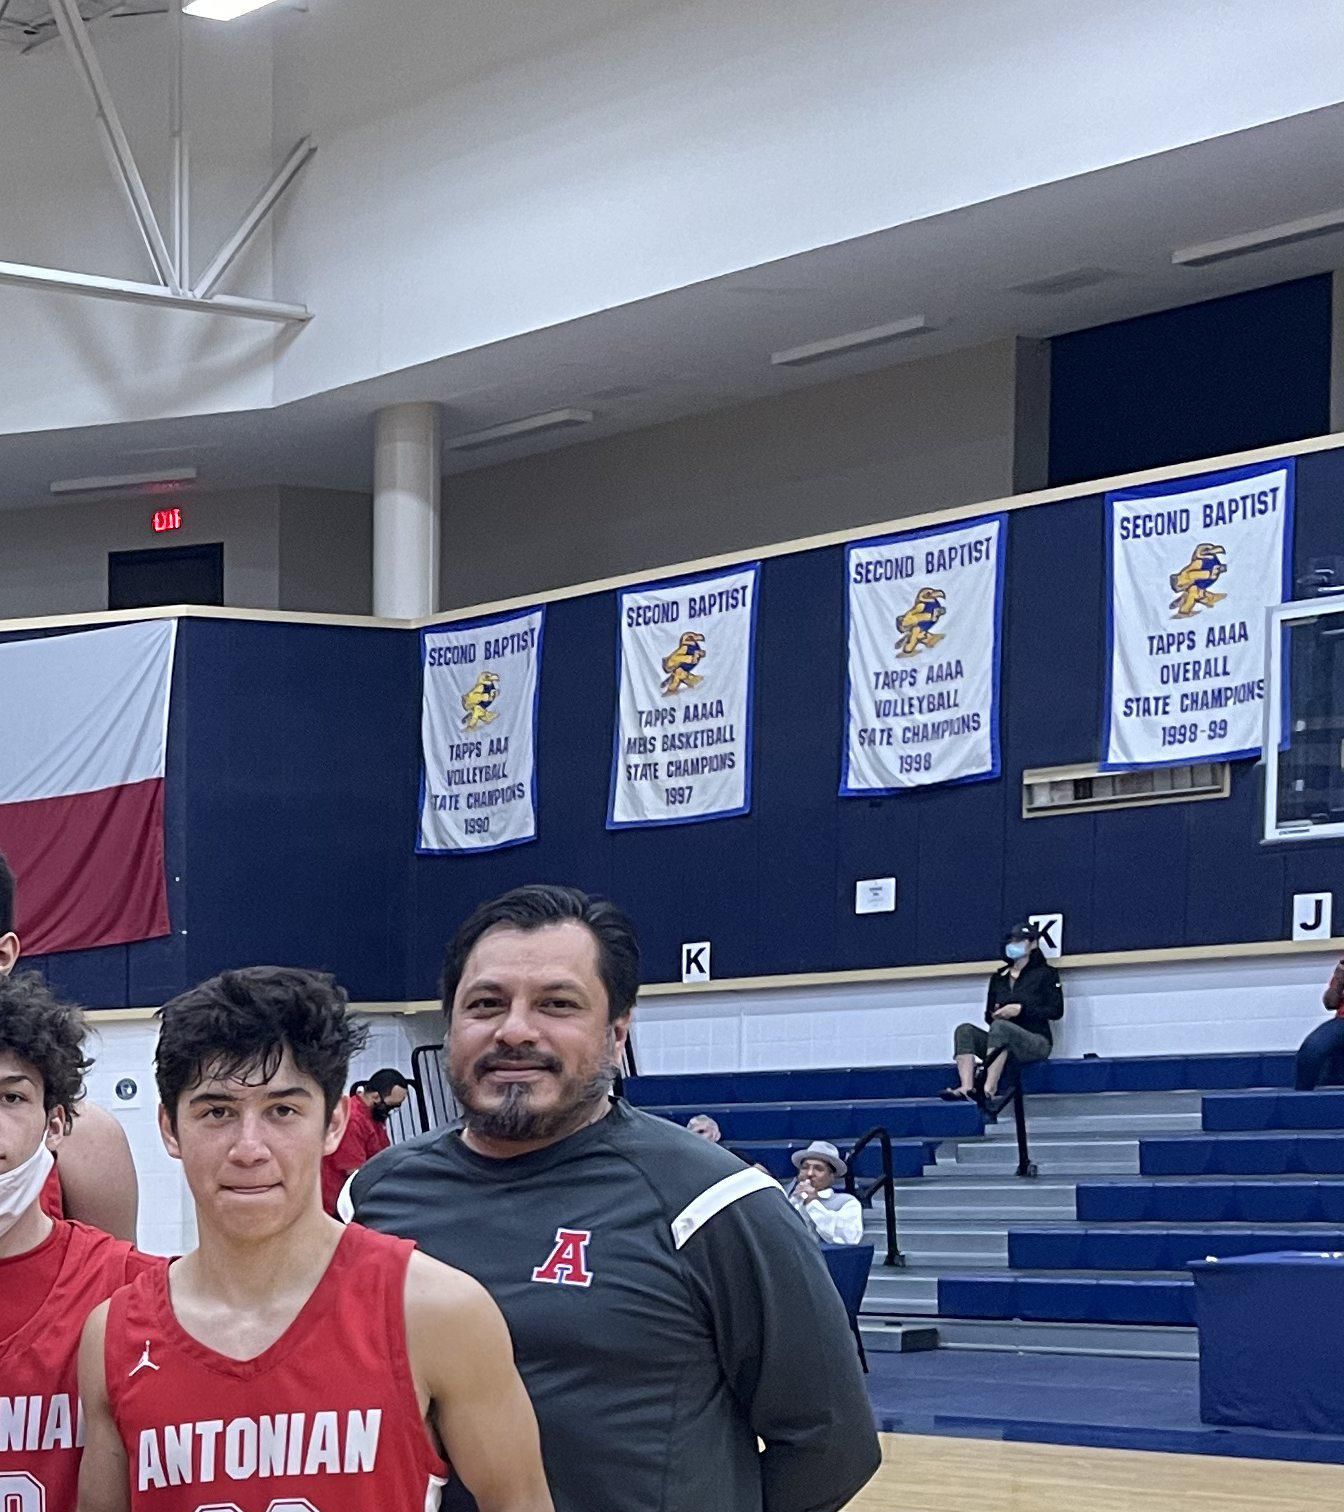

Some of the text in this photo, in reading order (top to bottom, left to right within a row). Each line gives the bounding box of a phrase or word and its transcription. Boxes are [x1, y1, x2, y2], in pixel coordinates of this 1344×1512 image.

[152, 508, 181, 532] EXIT
[1119, 486, 1280, 540] SECOND BAPTIST
[853, 536, 992, 584] SECOND BAPTIST
[626, 585, 748, 628] SECOND BAPTIST
[429, 627, 536, 666] SECOND BAPTIST
[1147, 621, 1249, 656] TAPPS AAAA
[873, 659, 964, 690] TAPPS AAAA
[1161, 656, 1230, 685] OVERALL
[875, 689, 959, 718] VOLLEYBALL
[1123, 679, 1265, 718] STATE CHAMPIONS
[638, 707, 676, 728] TAPPS
[902, 712, 981, 744] CHAMPIONS
[662, 724, 735, 752] BASKETBALL
[1162, 719, 1228, 747] 1998-99
[449, 741, 482, 761] TAPPS
[899, 752, 932, 773] 1998
[447, 763, 508, 786] VOLLEYBALL
[626, 752, 736, 781] STATE CHAMPIONS
[665, 786, 693, 806] 1997
[464, 817, 490, 835] 1990
[1300, 898, 1323, 931] J
[1034, 919, 1058, 949] K
[685, 947, 707, 976] K
[531, 1227, 594, 1288] A
[138, 1408, 382, 1491] ANTONIAN
